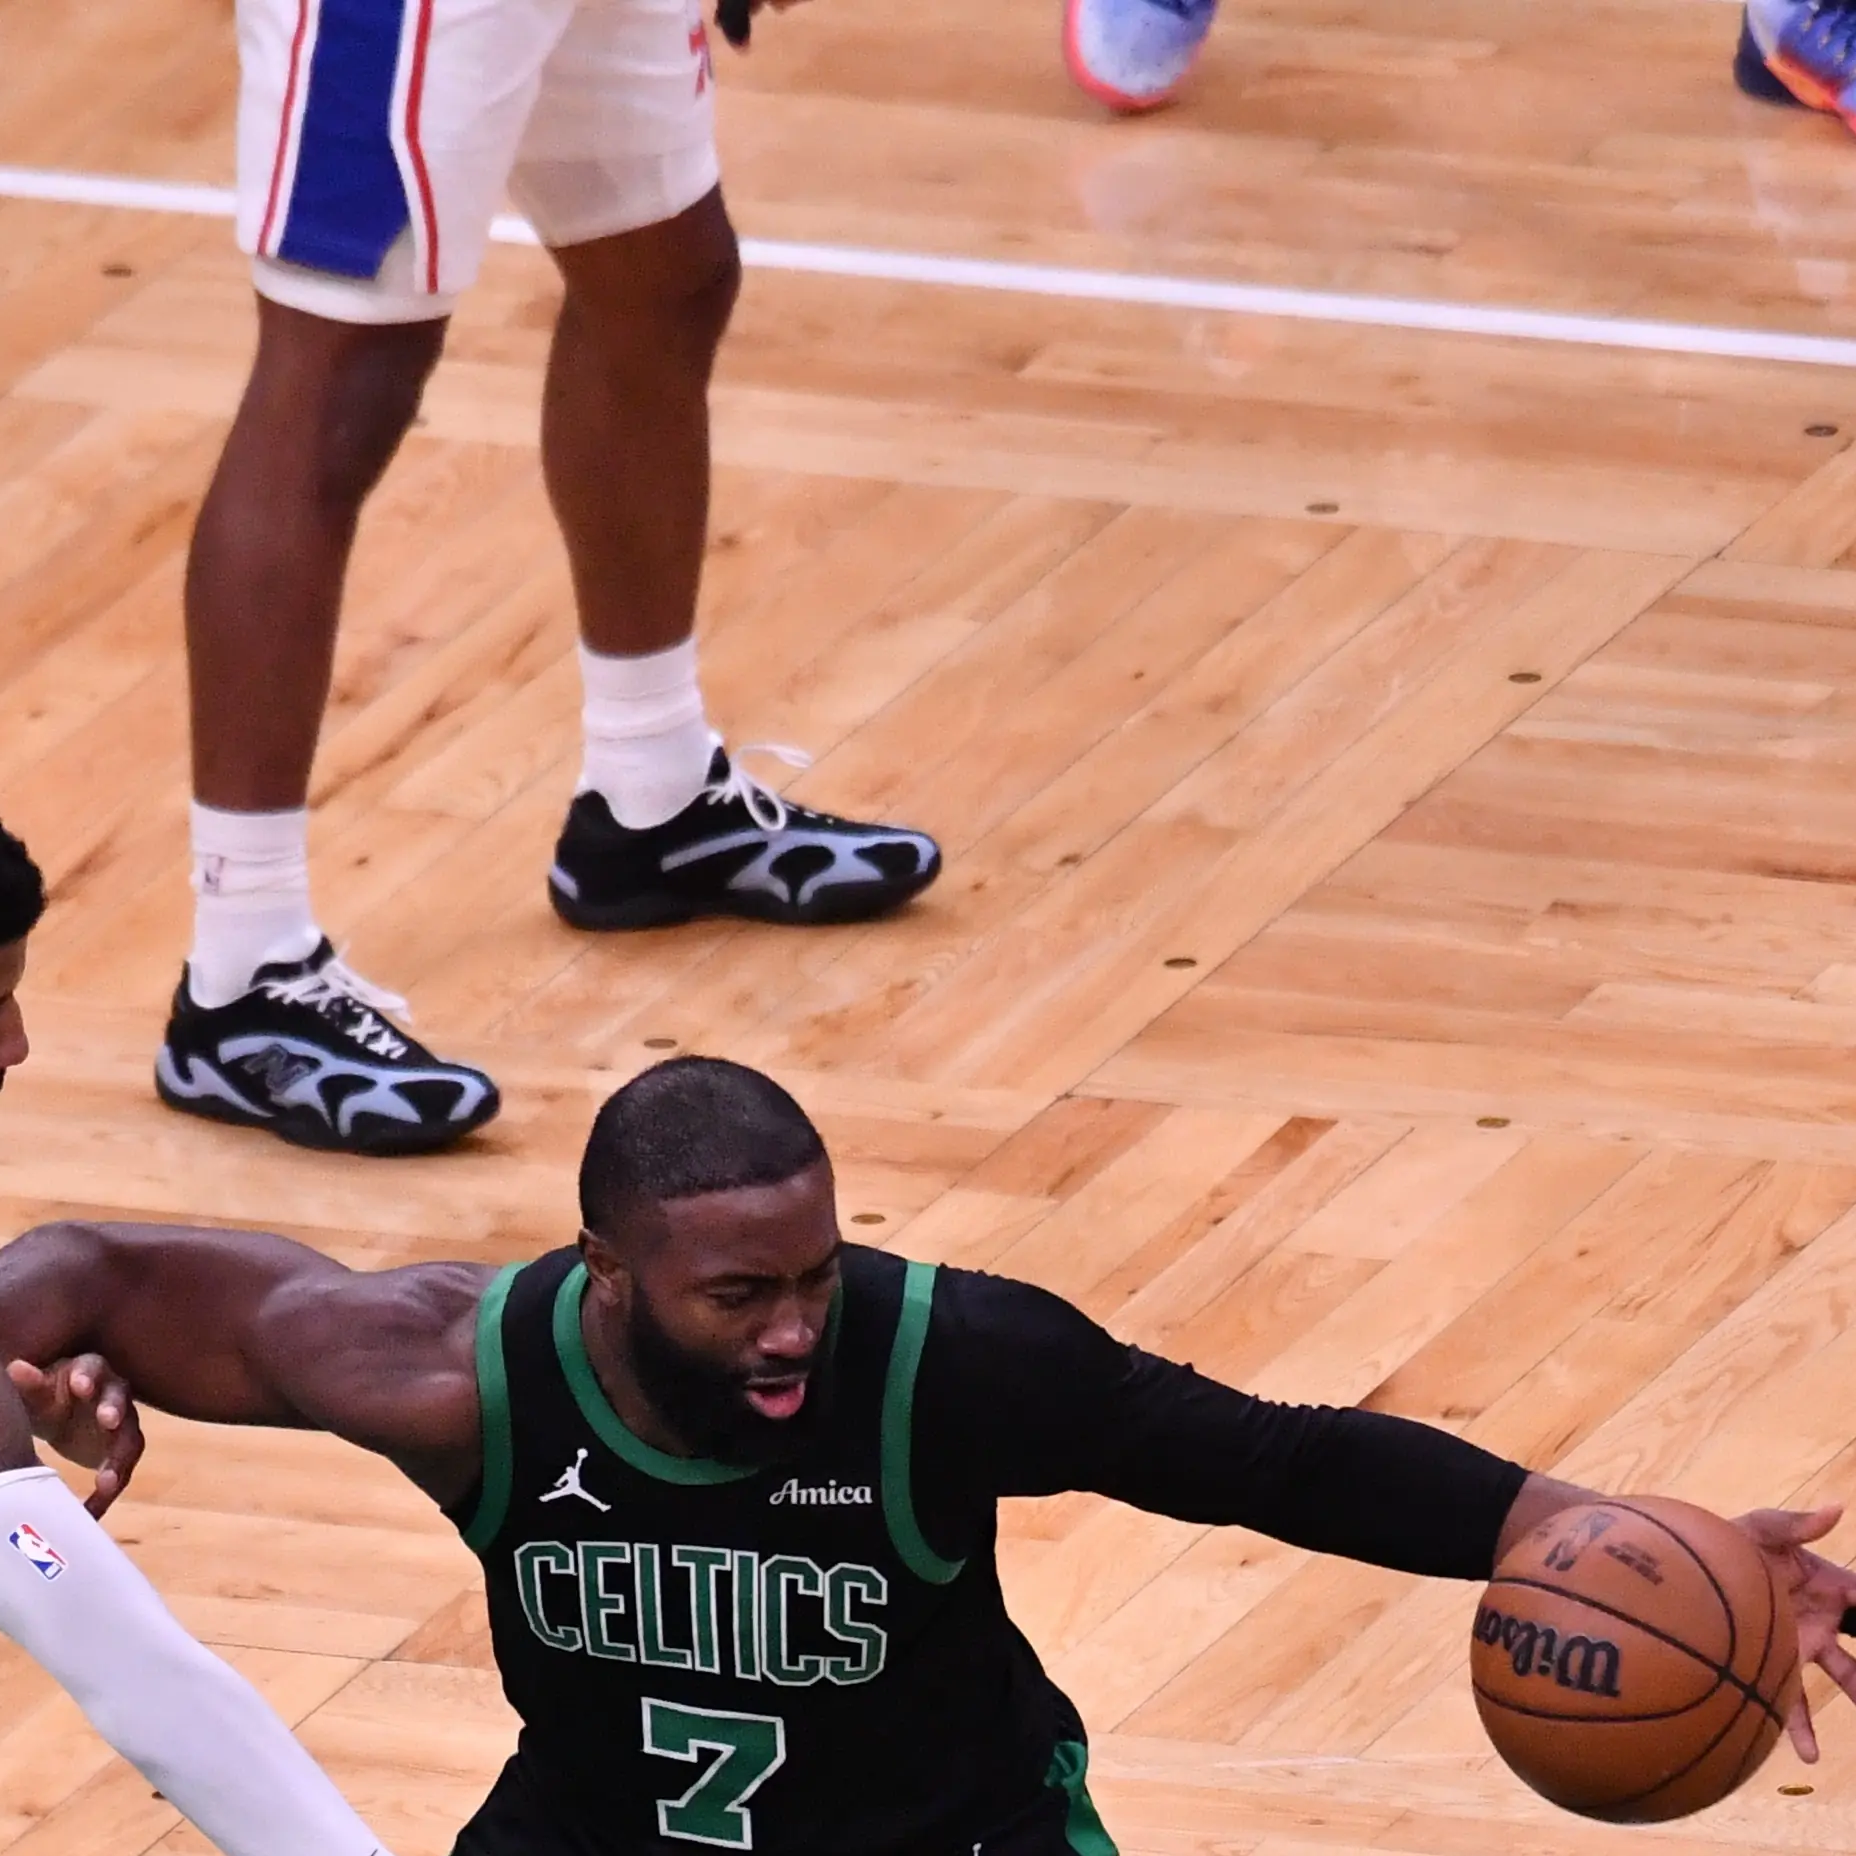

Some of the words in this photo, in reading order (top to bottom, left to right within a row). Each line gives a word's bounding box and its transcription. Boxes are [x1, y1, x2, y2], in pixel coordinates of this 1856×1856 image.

[769, 1478, 873, 1505] Amica
[513, 1540, 888, 1687] CELTICS
[641, 1696, 786, 1851] 7
